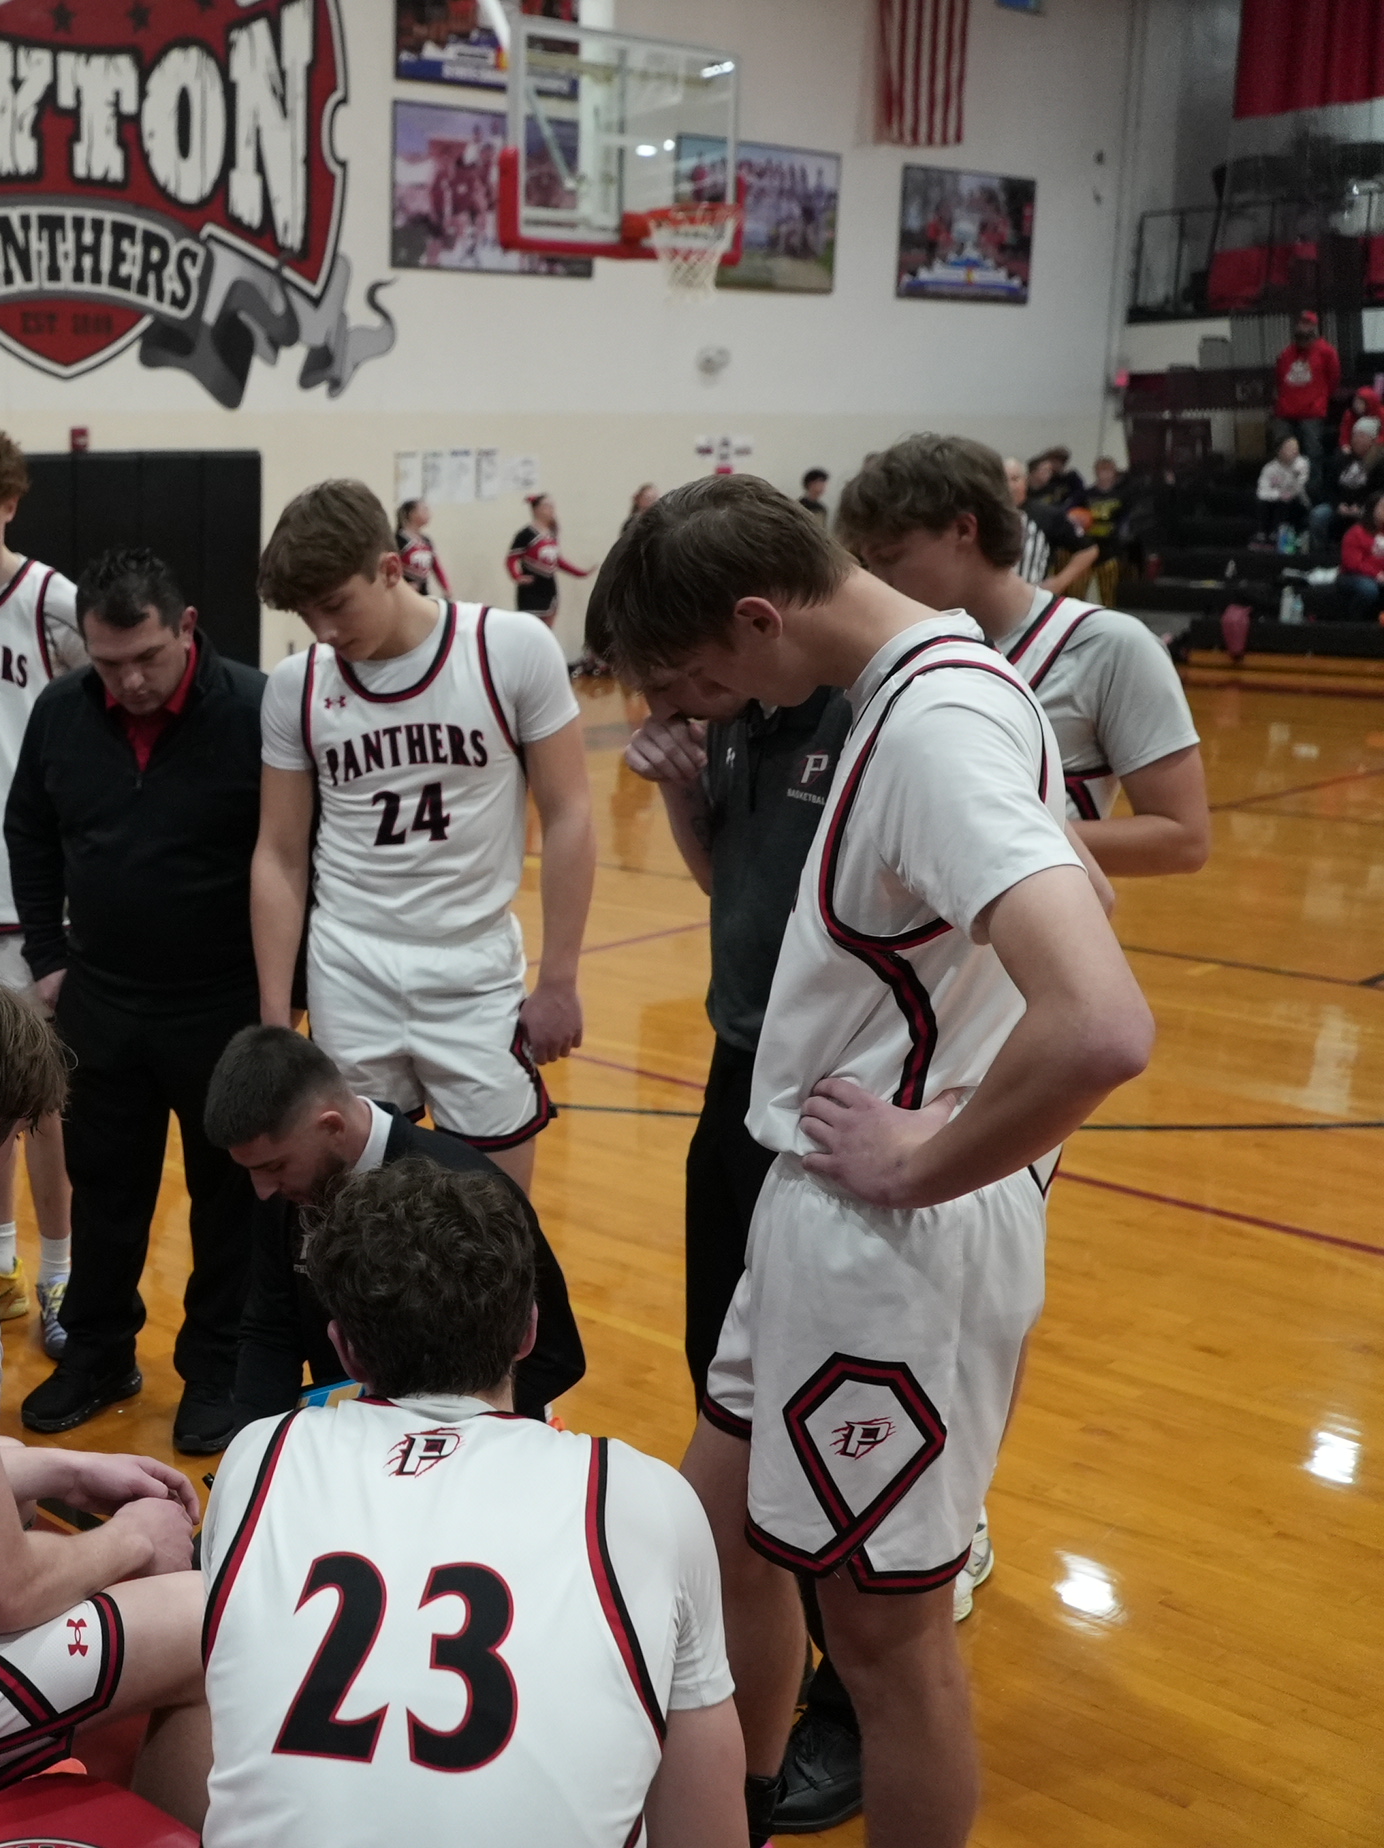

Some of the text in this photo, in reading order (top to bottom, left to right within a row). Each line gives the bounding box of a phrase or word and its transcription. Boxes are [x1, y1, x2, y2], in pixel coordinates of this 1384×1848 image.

[326, 723, 488, 786] PANTHERS
[372, 782, 450, 846] 24
[271, 1551, 518, 1774] 23
